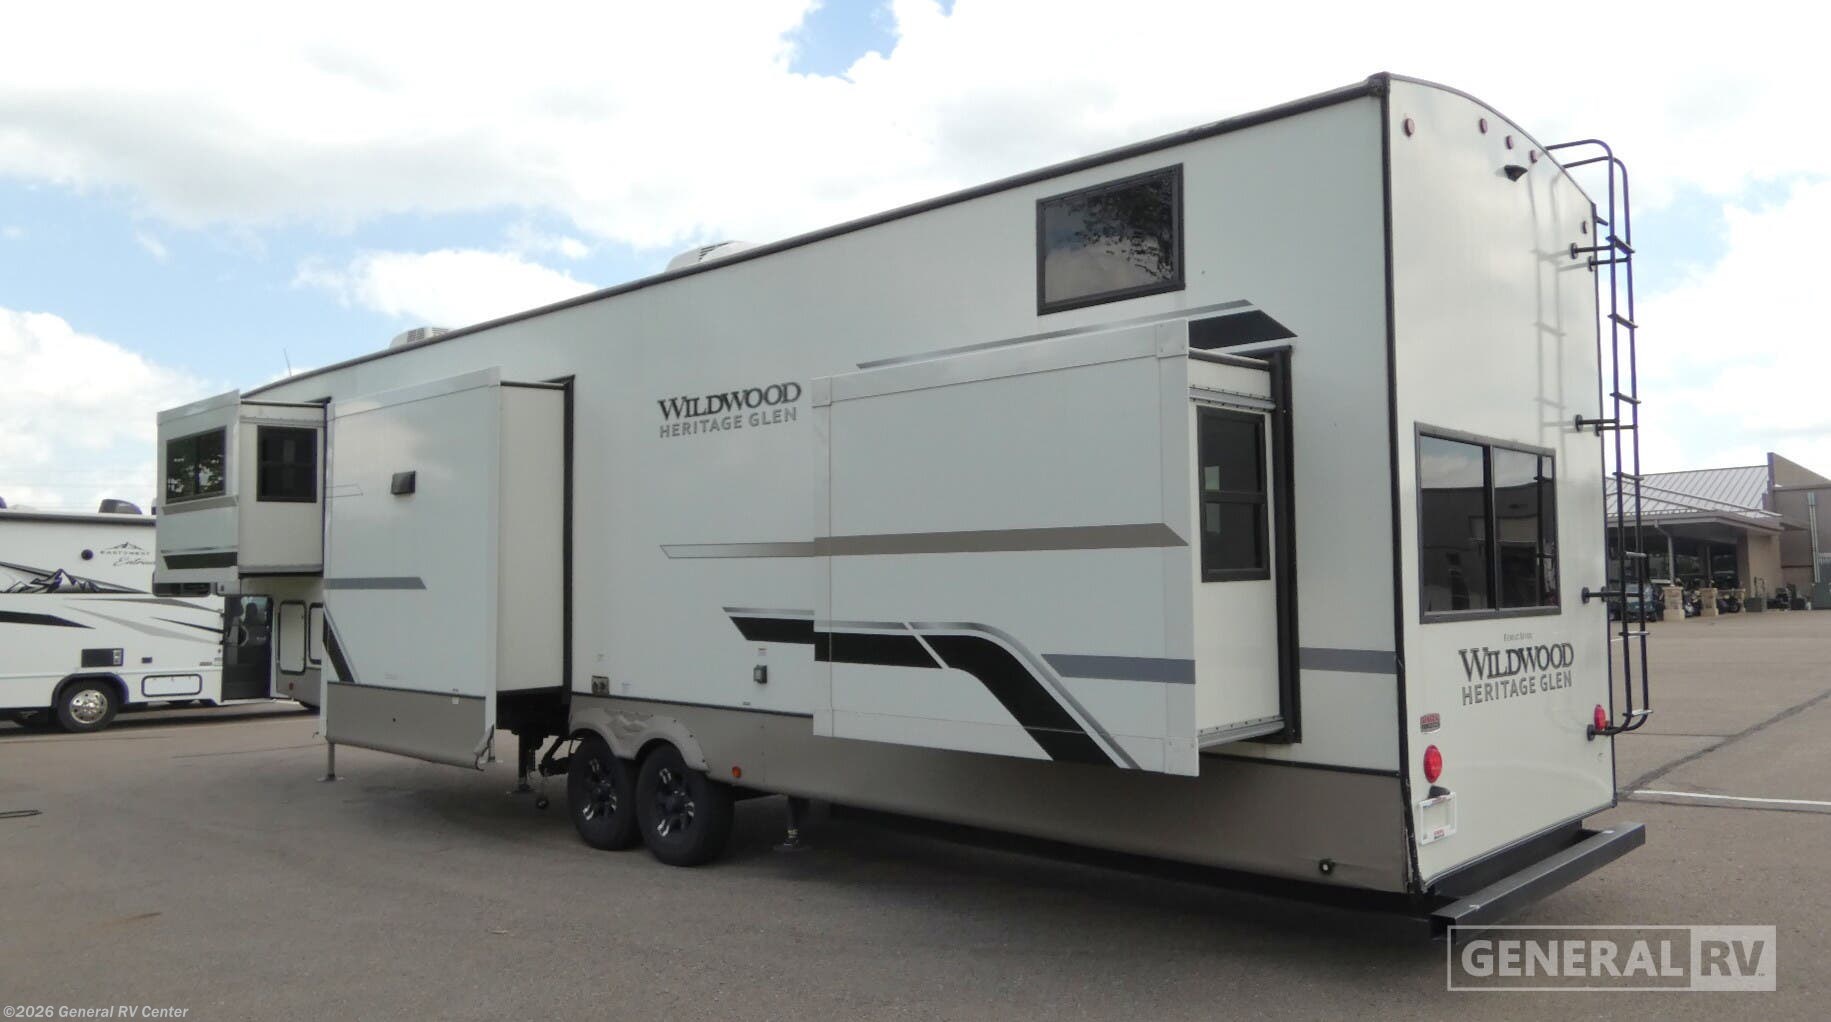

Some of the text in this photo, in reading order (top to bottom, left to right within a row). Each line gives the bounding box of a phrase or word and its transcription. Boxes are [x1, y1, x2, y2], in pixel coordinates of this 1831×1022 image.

[658, 382, 801, 420] WILDWOOD
[660, 406, 797, 438] HERITAGE GLEN
[1458, 643, 1574, 682] WILDWOOD
[1462, 670, 1572, 706] HERITAGE GLEN
